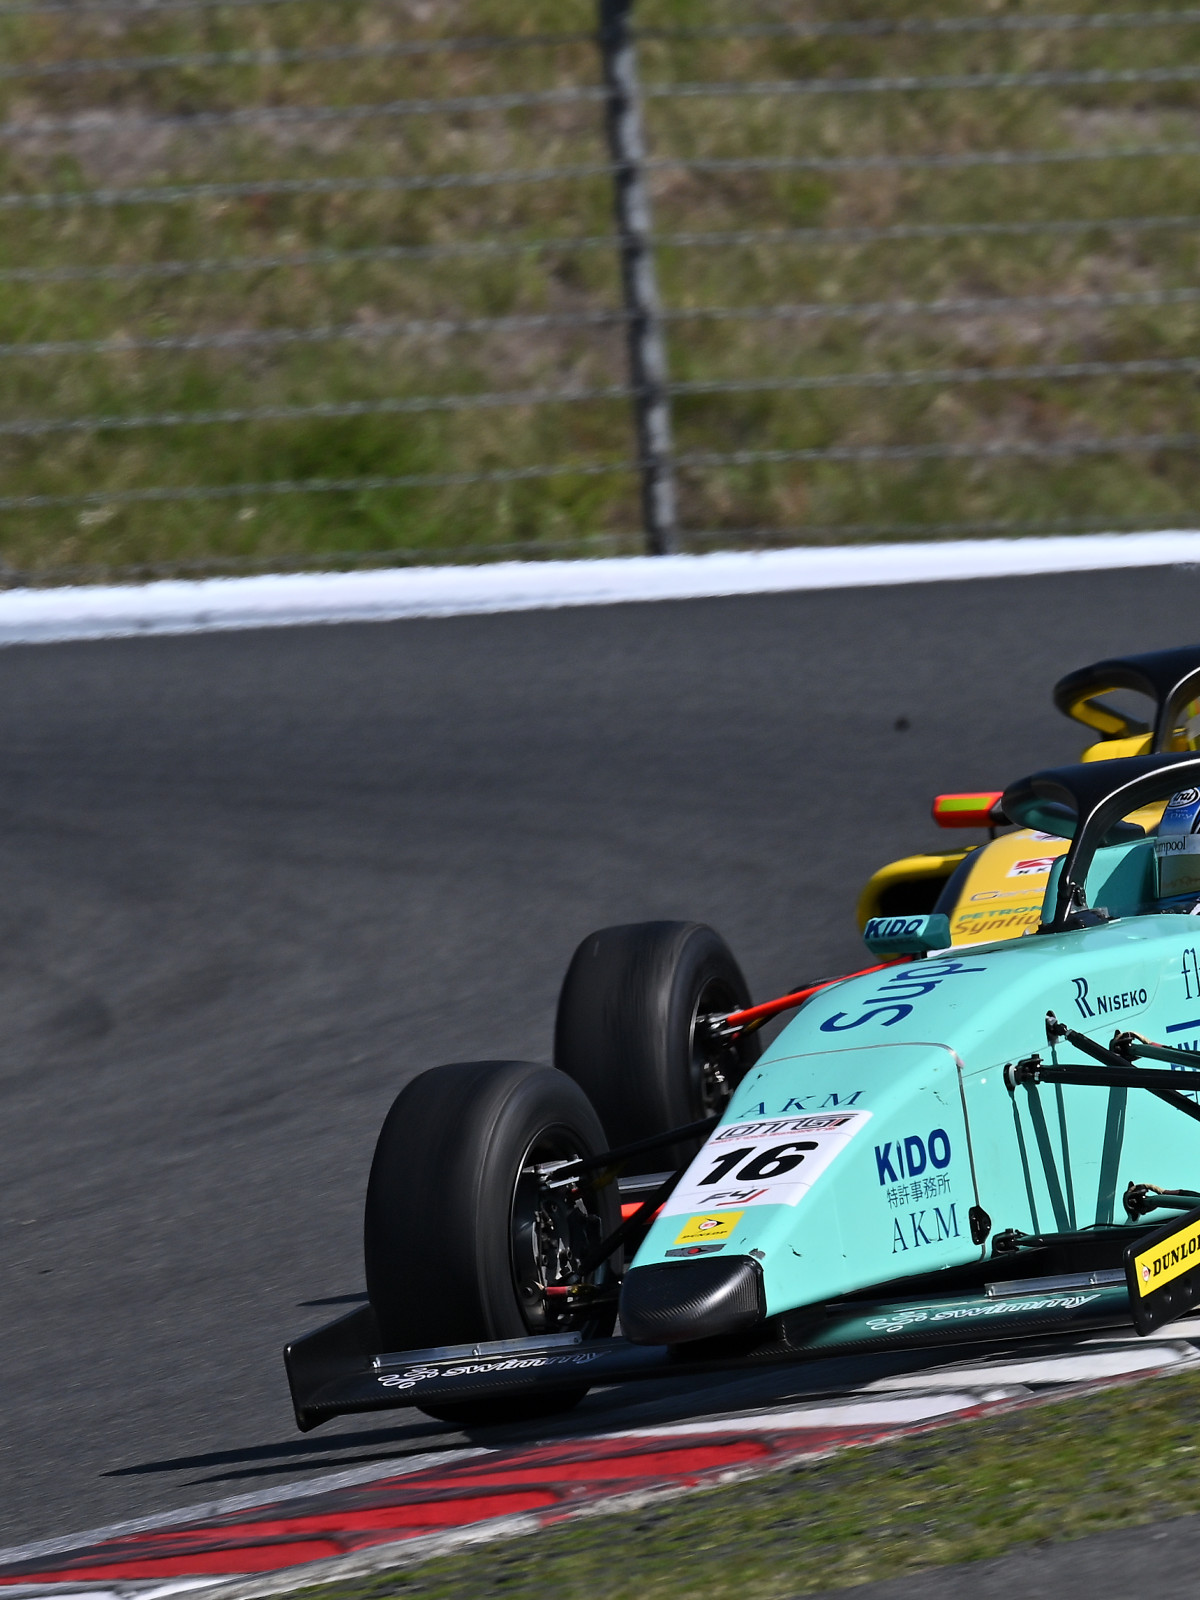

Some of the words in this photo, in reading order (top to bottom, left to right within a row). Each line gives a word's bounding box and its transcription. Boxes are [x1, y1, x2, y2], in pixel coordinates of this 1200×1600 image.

[864, 919, 923, 940] KIDO
[819, 959, 987, 1032] Sup
[1097, 988, 1147, 1015] NISEKO
[736, 1090, 866, 1119] AKM
[697, 1141, 819, 1187] 16
[874, 1128, 951, 1186] KIDO
[886, 1172, 951, 1209] 特許事務所
[891, 1202, 961, 1254] AKM
